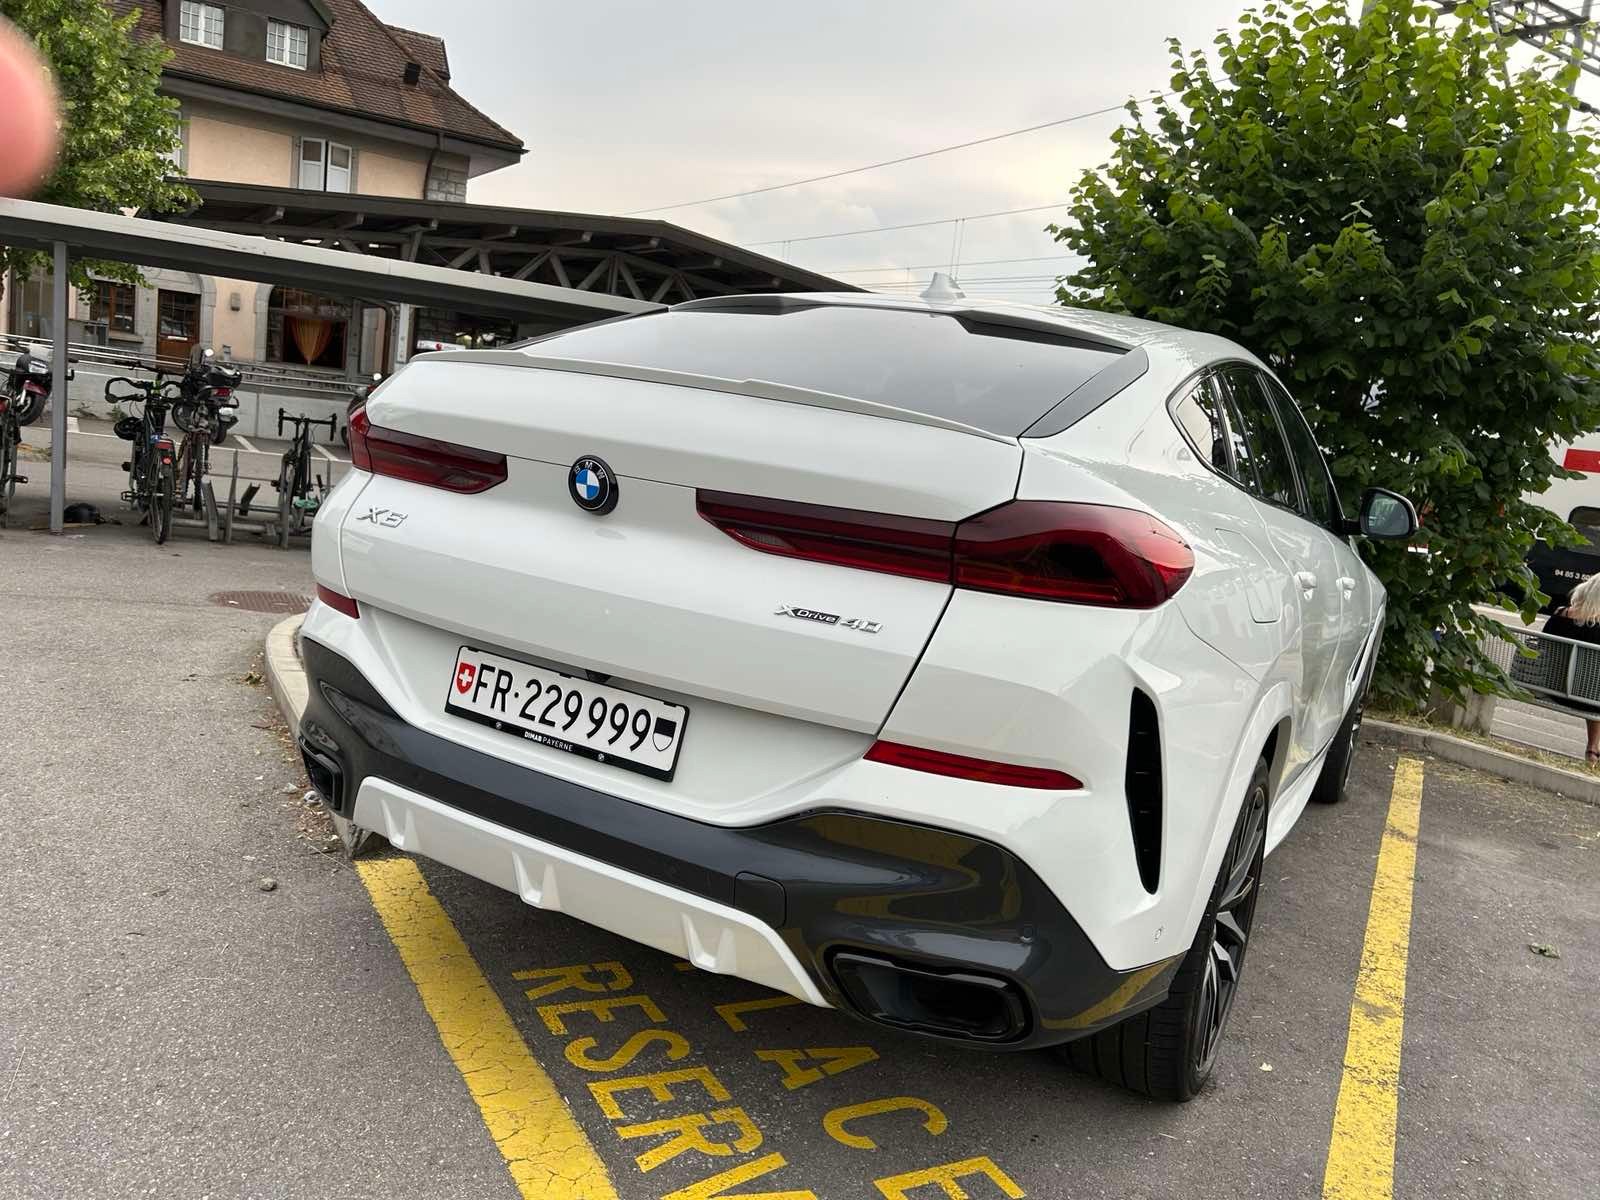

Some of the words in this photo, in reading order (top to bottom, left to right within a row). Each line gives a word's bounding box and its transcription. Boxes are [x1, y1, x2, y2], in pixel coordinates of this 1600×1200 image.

[575, 461, 606, 480] BMW
[356, 506, 409, 529] X6
[840, 618, 883, 634] 40
[542, 736, 574, 752] PAYERNE
[673, 961, 1026, 1200] LACE
